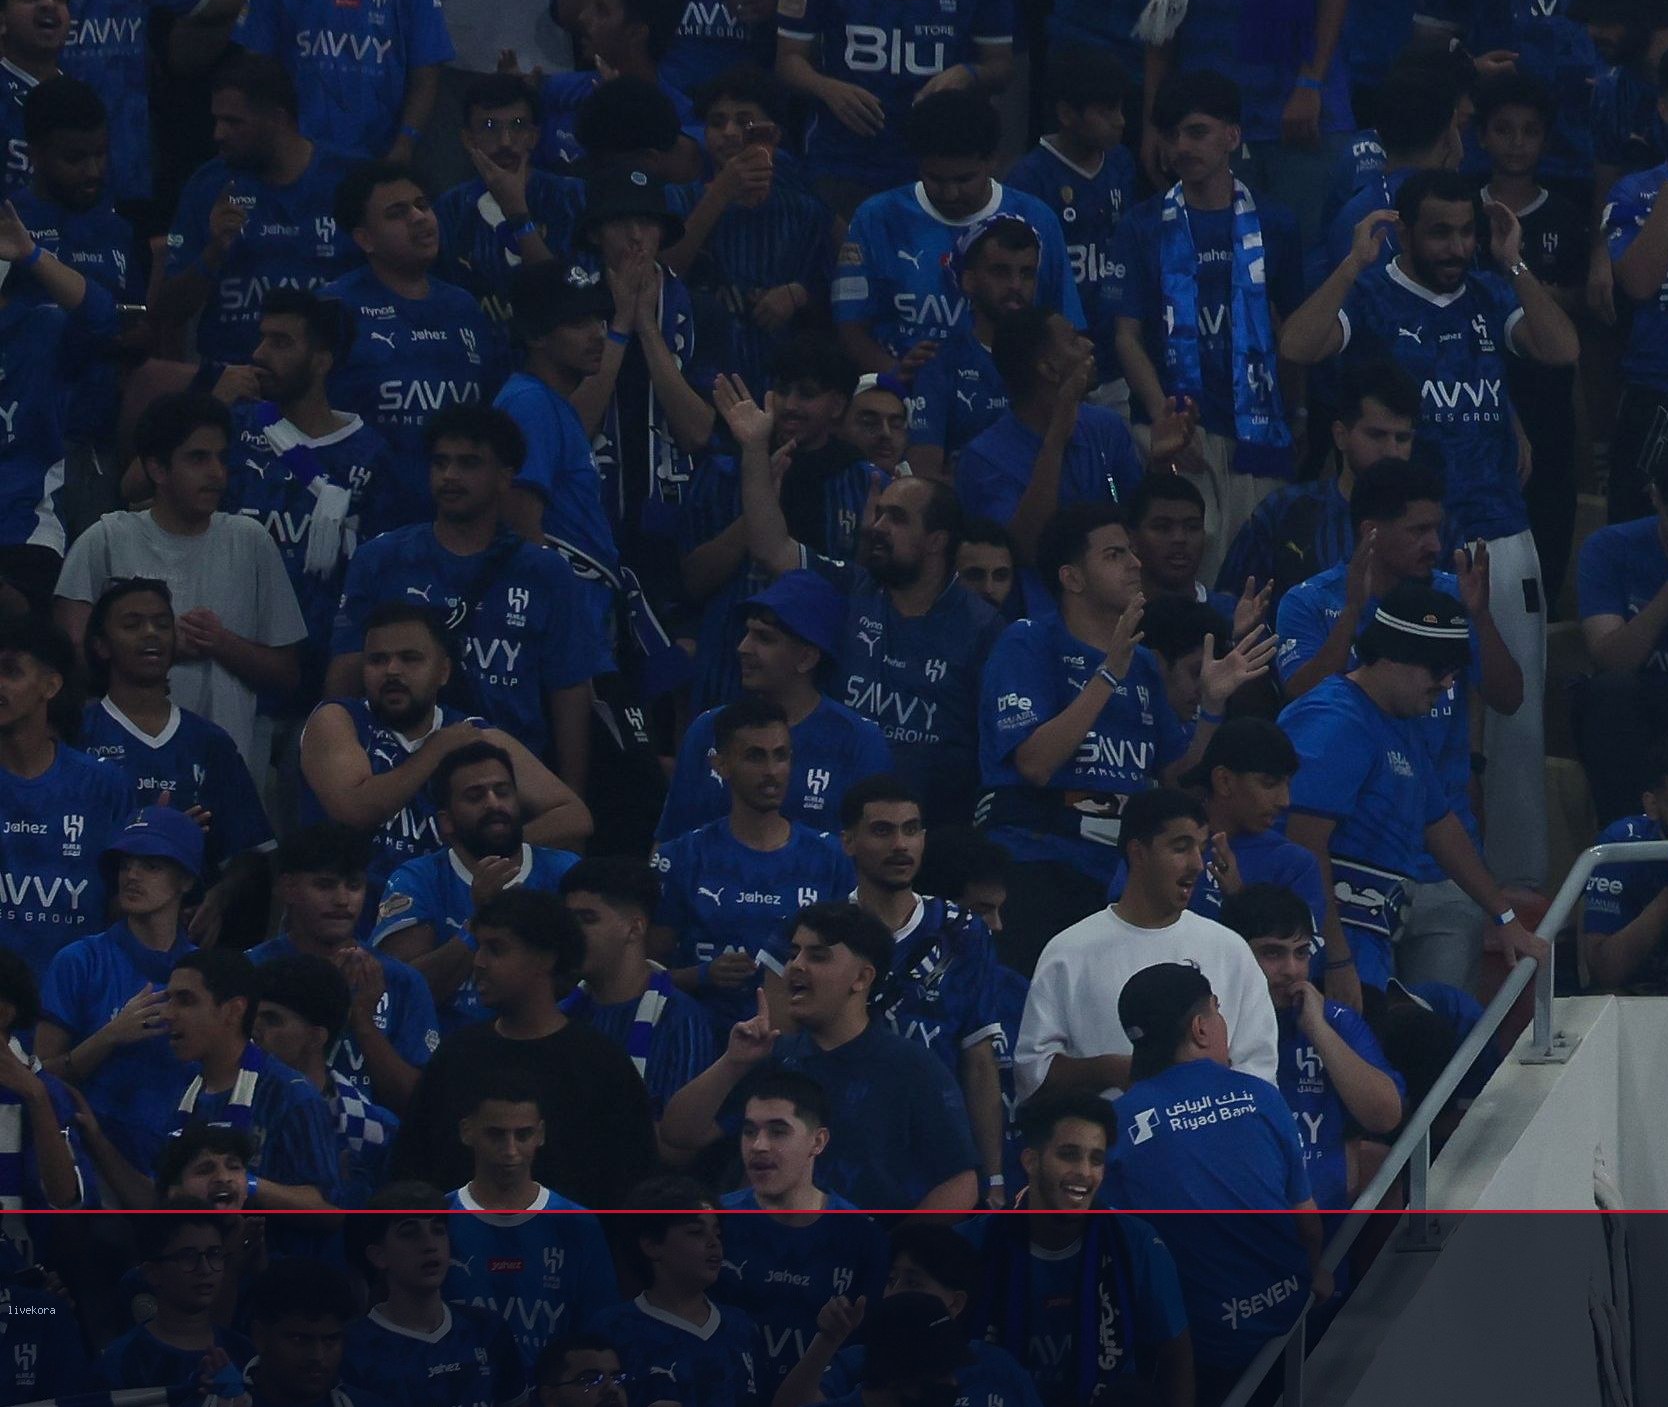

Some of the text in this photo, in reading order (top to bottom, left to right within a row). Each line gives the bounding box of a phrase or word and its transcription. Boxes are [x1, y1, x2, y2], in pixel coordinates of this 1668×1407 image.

[67, 16, 143, 48] SAVVY
[298, 30, 392, 64] SAVVY
[845, 26, 944, 76] Blu
[378, 381, 480, 410] SAVV
[1421, 380, 1501, 407] AVVY
[378, 413, 424, 425] GAME
[1463, 412, 1498, 422] GROU
[24, 911, 85, 924] GROUP
[1166, 1092, 1254, 1118] بنك الرياض
[1171, 1111, 1217, 1132] Riyad
